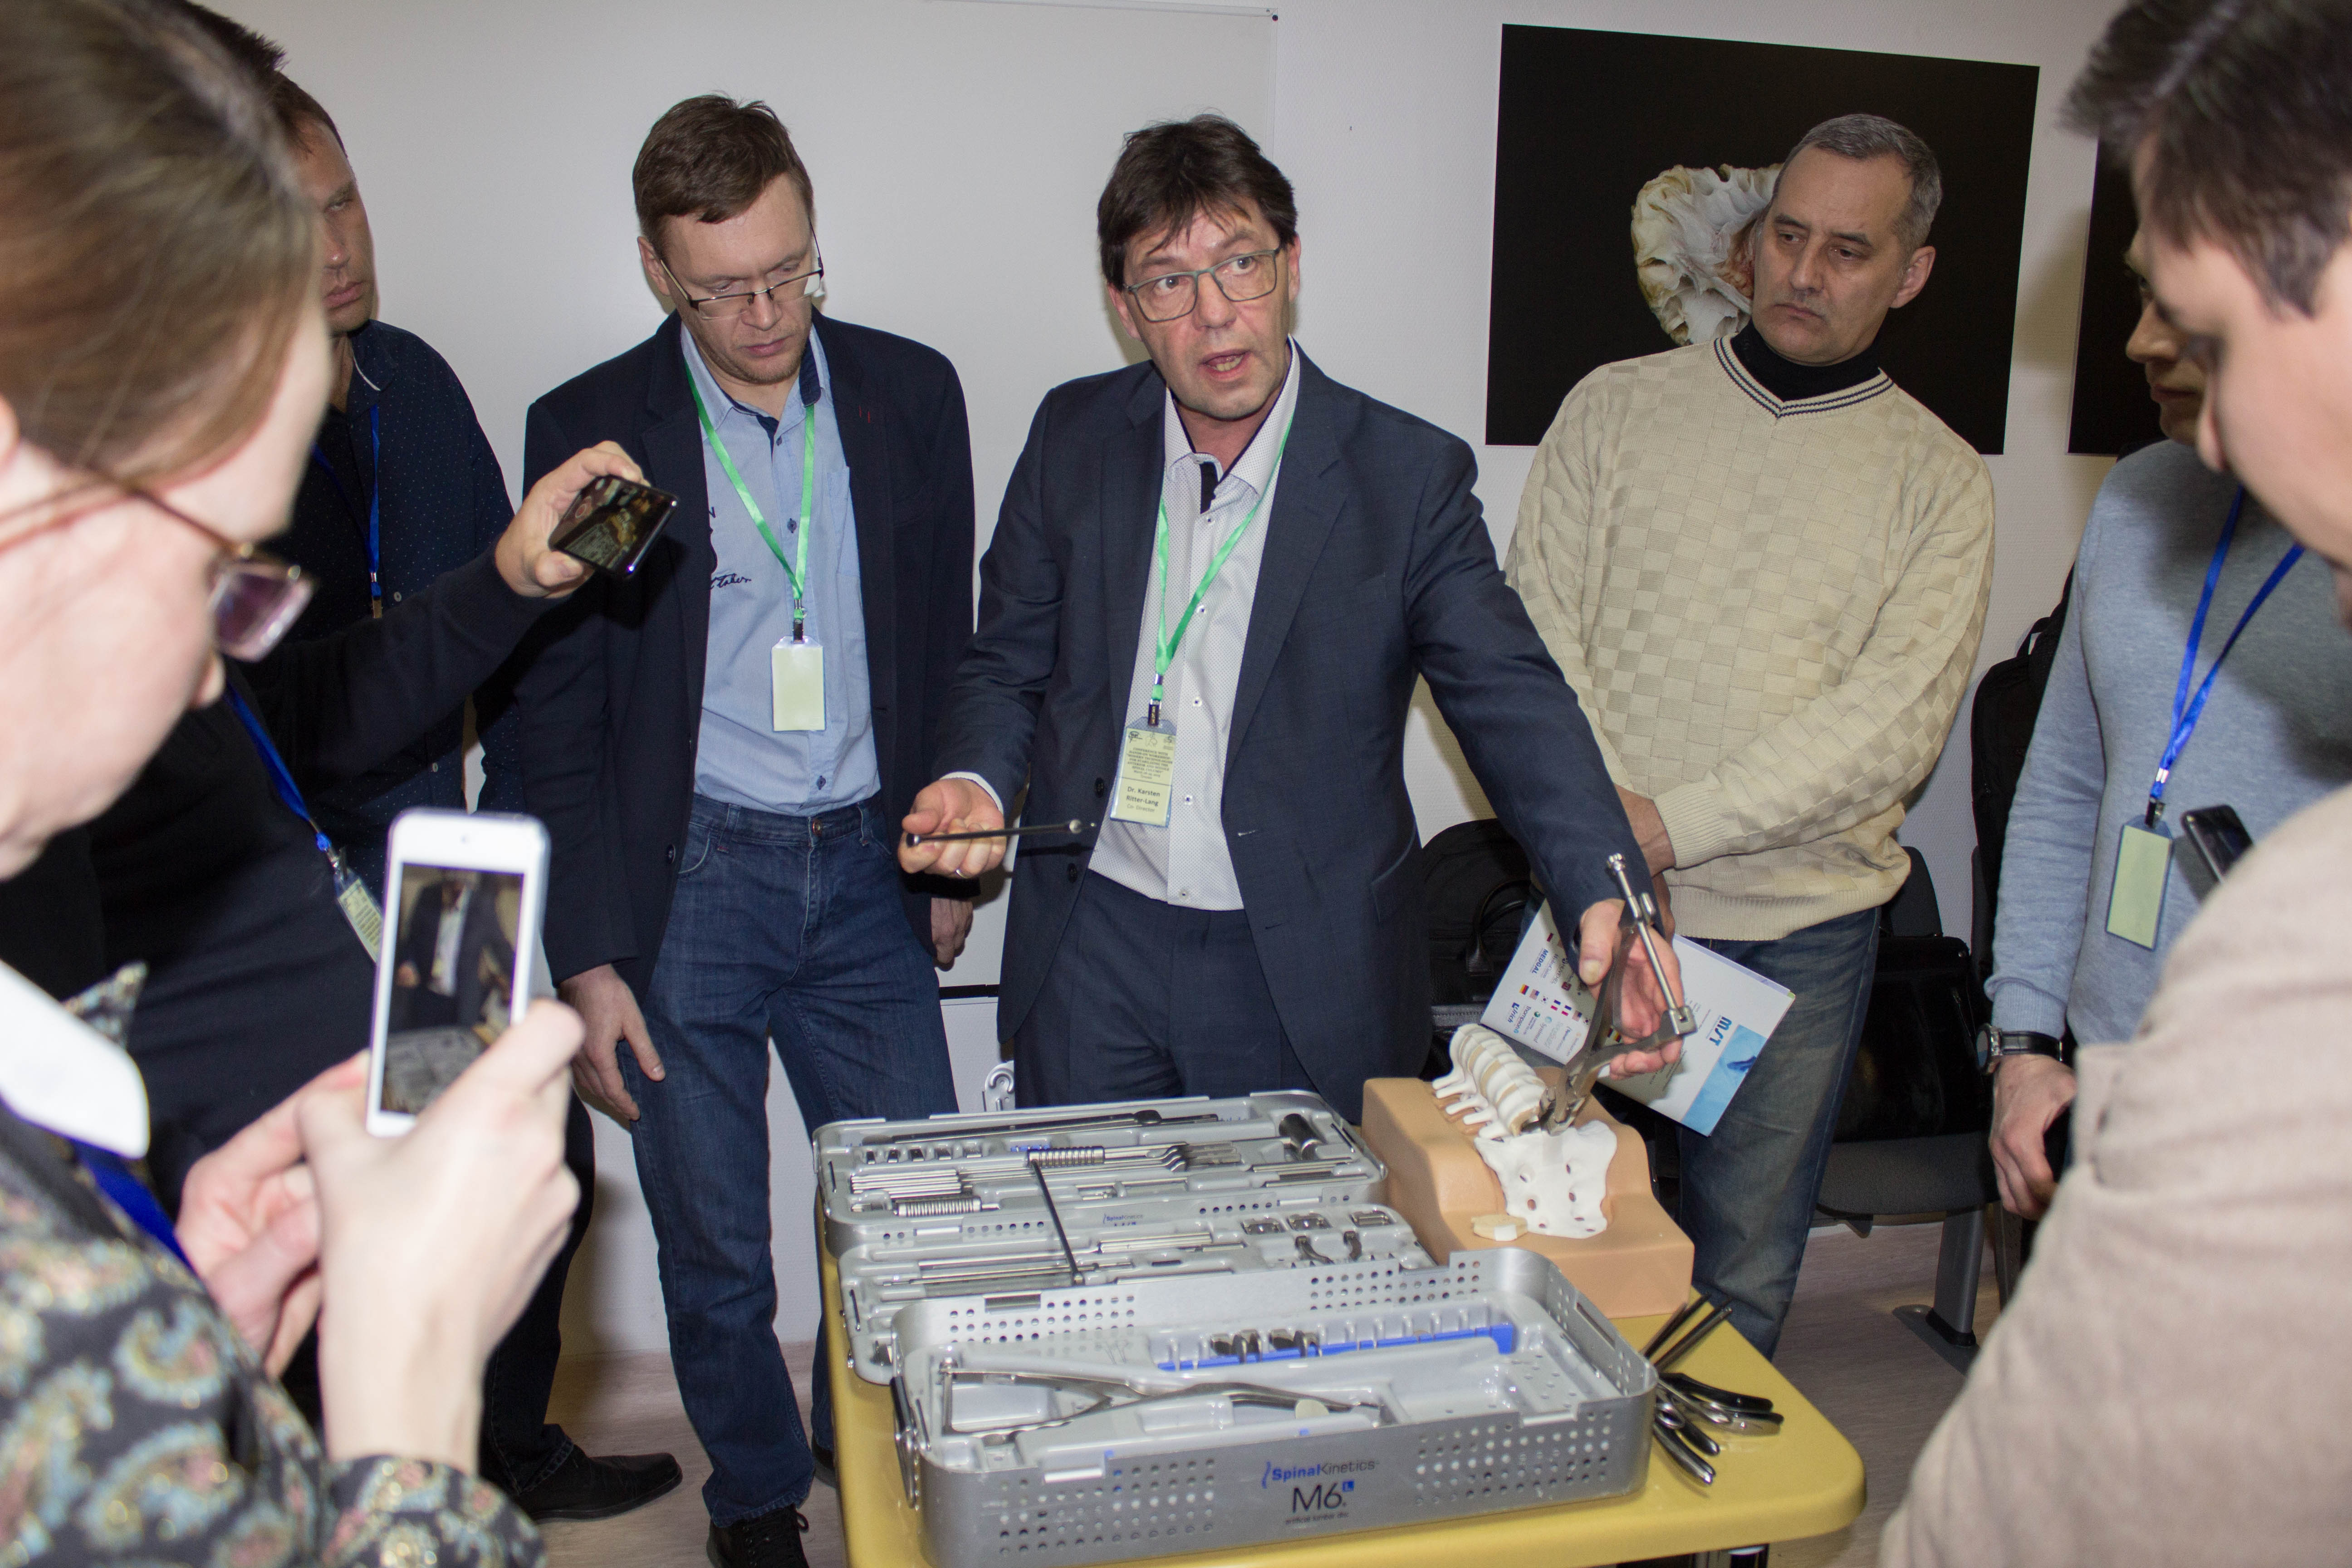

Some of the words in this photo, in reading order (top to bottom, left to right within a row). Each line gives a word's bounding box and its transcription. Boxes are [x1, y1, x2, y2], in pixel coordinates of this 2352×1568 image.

[1126, 795, 1159, 806] Ritter-Lang
[1138, 788, 1160, 797] Karsten
[1532, 949, 1548, 974] MEDGAL
[1516, 1005, 1531, 1029] Thompson
[1709, 1016, 1732, 1046] MST
[1272, 1460, 1375, 1483] SpinalKinetics
[1292, 1482, 1343, 1514] M6
